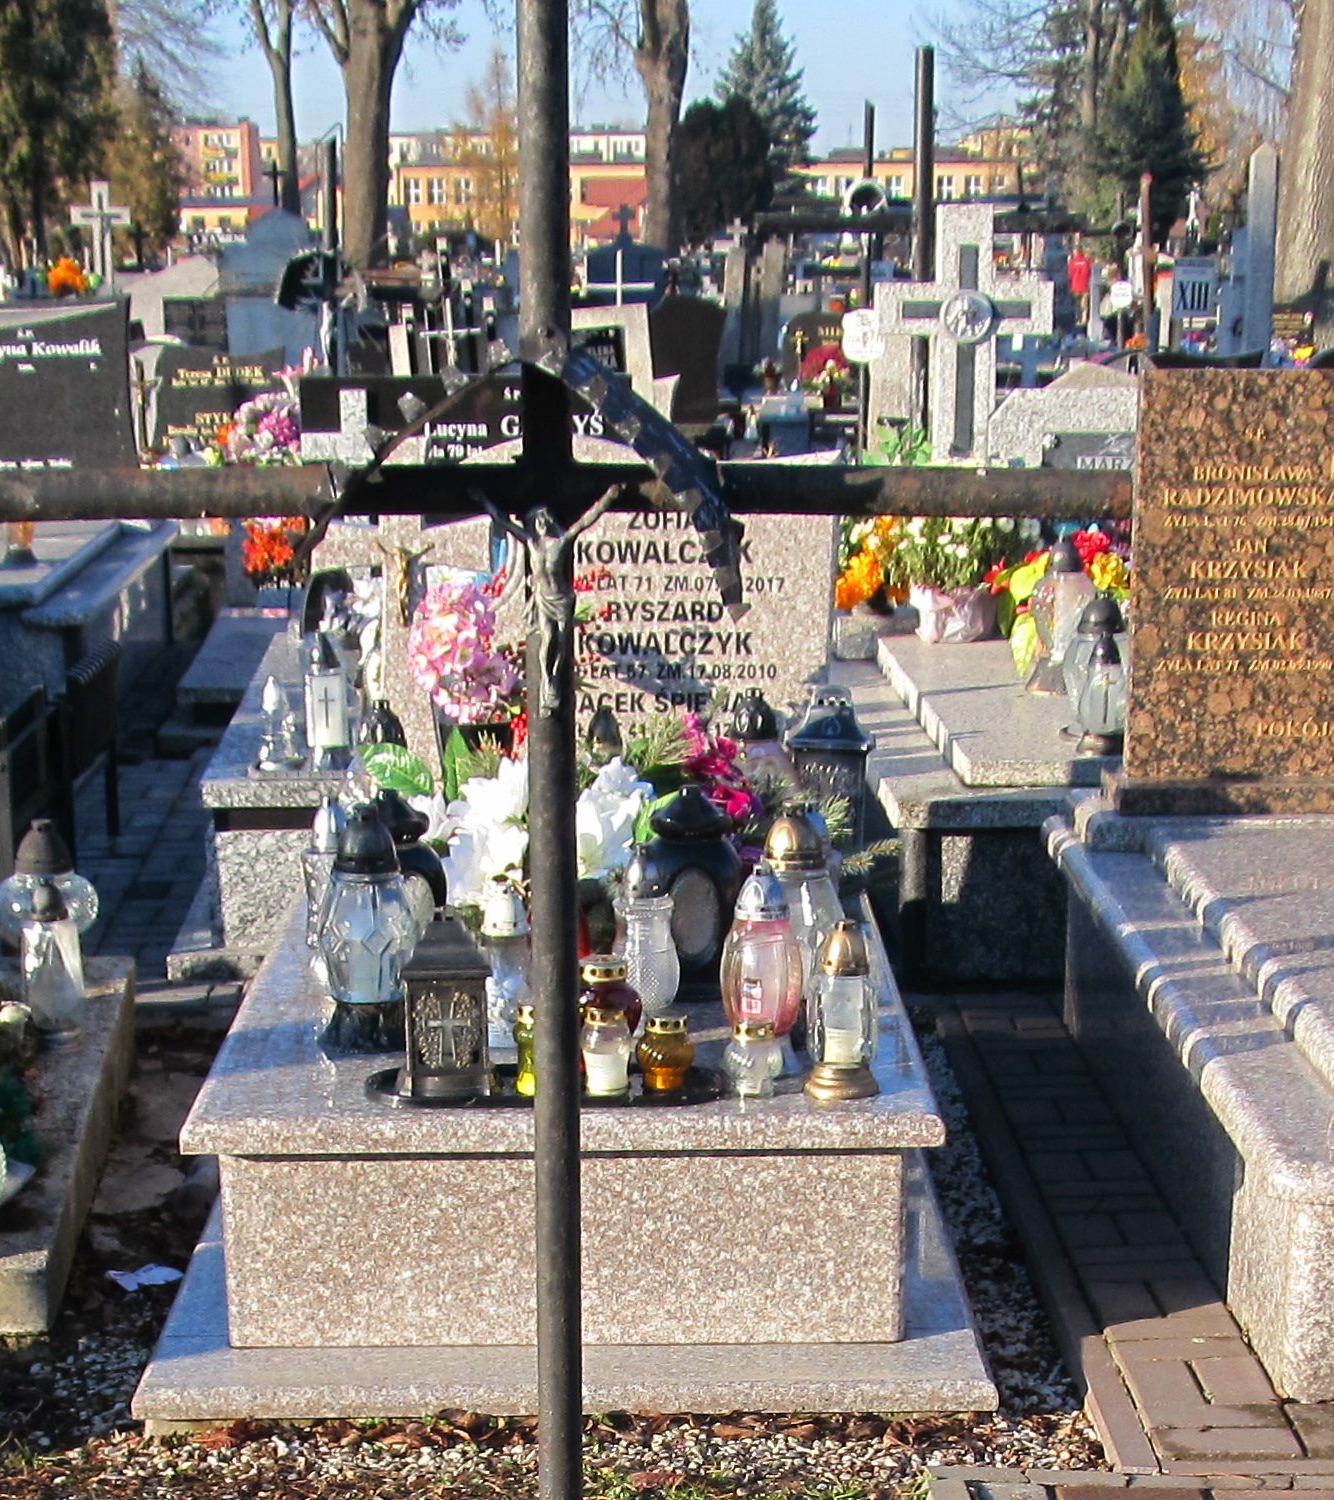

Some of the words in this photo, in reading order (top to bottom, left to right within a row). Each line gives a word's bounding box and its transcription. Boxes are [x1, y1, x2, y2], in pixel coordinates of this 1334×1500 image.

[1176, 281, 1210, 311] XIII
[447, 443, 464, 458] 79
[1194, 466, 1314, 482] BRONISŁAWA
[577, 540, 753, 564] KOWALCK
[1232, 538, 1267, 553] JAN
[1189, 560, 1309, 579] KRZYSIAK
[634, 576, 652, 592] 71
[608, 601, 724, 622] RYSZARD
[1211, 611, 1283, 626] REGINA
[578, 631, 753, 655] KOWALCZYK
[1186, 632, 1305, 651] KRZYSIAK
[578, 692, 645, 713] ACEK
[1257, 717, 1330, 737] POKÓJ
